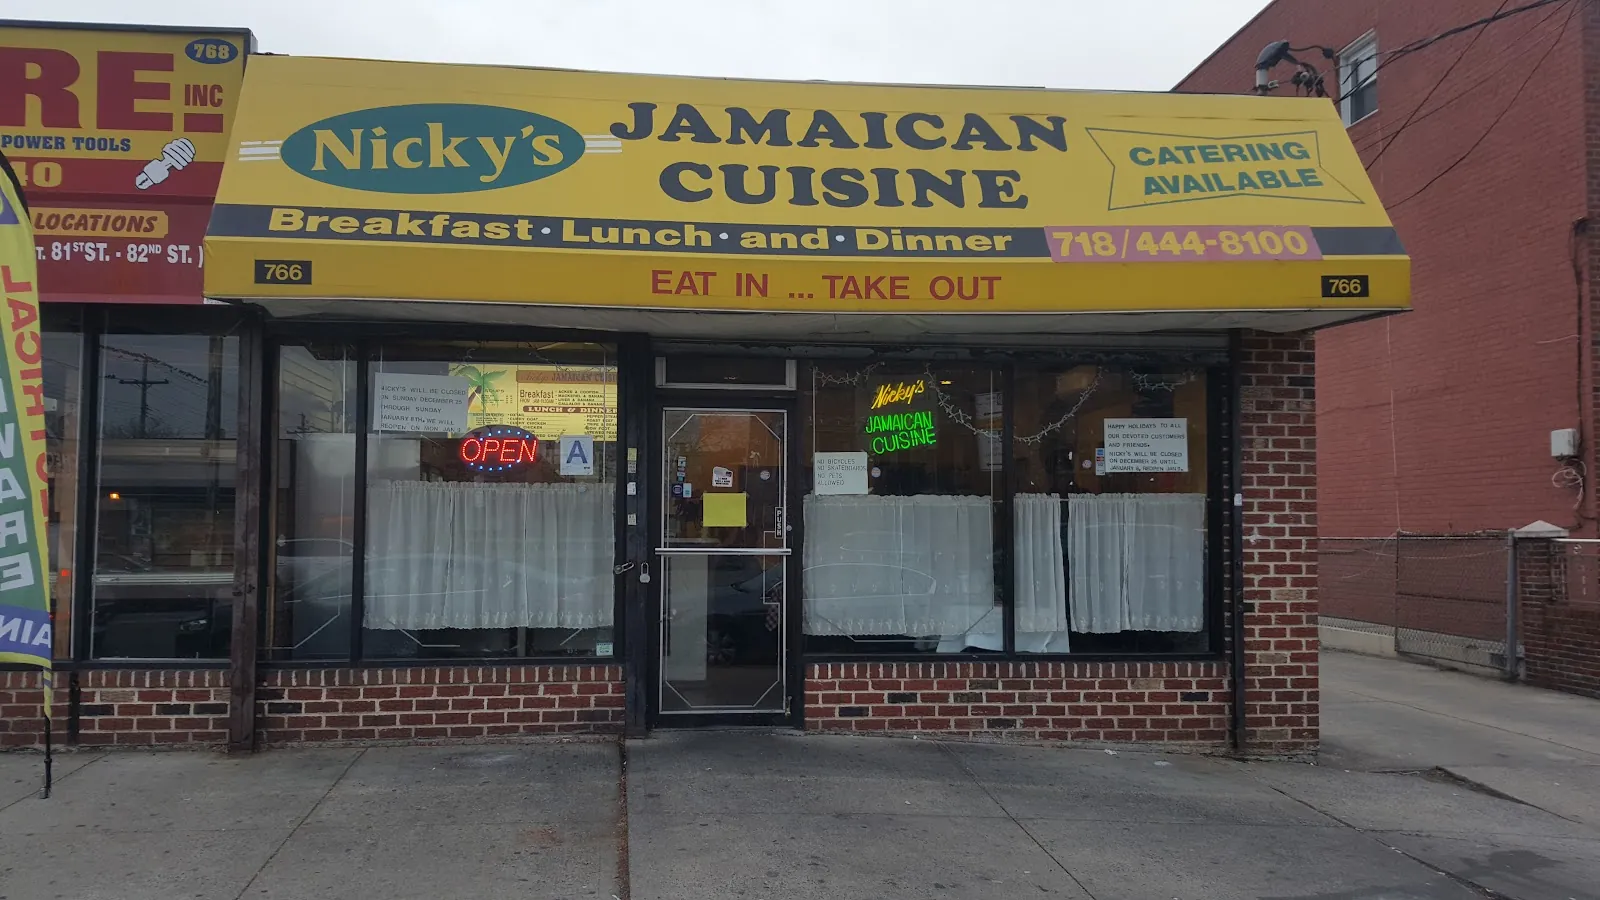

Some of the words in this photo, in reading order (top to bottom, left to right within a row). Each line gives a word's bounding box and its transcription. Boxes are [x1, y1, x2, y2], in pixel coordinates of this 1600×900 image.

[193, 43, 230, 60] 768
[184, 84, 223, 107] INC
[609, 102, 1068, 153] JAMAICAN
[1, 134, 65, 150] POWER
[72, 137, 131, 152] TOOLS
[310, 122, 564, 183] Nicky's
[1129, 141, 1310, 167] CATERING
[658, 161, 1028, 210] CUISINE
[1144, 168, 1323, 195] AVAILABLE
[34, 212, 158, 233] LOCATIONS
[268, 207, 534, 242] Breakfast
[562, 221, 713, 248] Lunch
[739, 227, 830, 251] and
[856, 228, 1012, 251] Dinner
[263, 263, 303, 281] 766
[651, 269, 717, 296] EAT
[736, 273, 769, 298] IN
[822, 274, 910, 300] TAKE
[929, 275, 1002, 301] OUT
[1328, 278, 1361, 295] 766
[519, 389, 554, 399] Breakfast
[871, 379, 925, 409] Nicky's
[865, 411, 934, 434] JAMAICAN
[461, 438, 537, 463] OPEN
[566, 440, 588, 464] A
[872, 428, 937, 455] CUISINE
